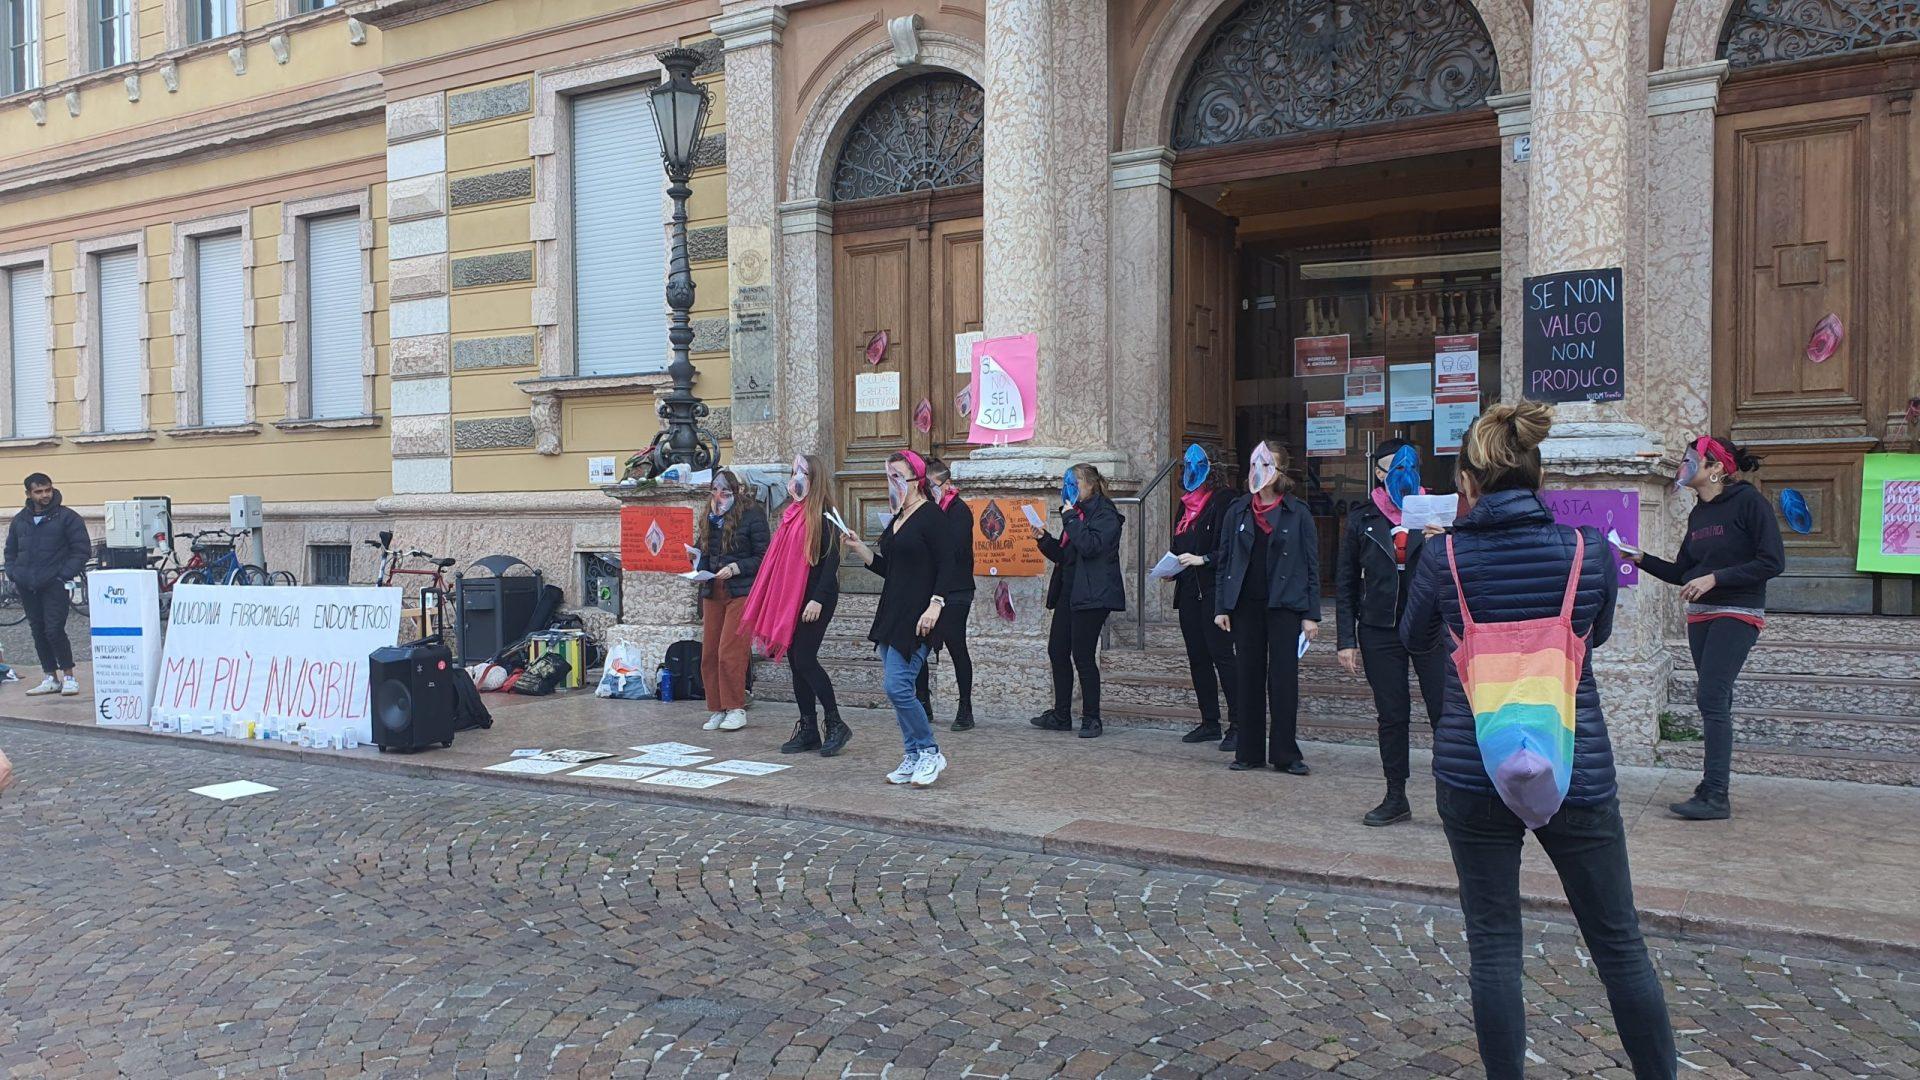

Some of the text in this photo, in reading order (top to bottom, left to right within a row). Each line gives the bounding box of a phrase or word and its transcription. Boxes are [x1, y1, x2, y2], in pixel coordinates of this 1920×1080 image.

[1530, 276, 1615, 311] SE NON
[1539, 311, 1602, 338] VALGO
[1551, 340, 1596, 361] NON
[1532, 366, 1618, 393] PRODUCO
[991, 391, 1009, 405] SEI
[981, 406, 1017, 425] SOLA
[1551, 499, 1593, 516] ASTA
[107, 585, 126, 596] Puro
[159, 656, 205, 710] MAI
[208, 650, 254, 712] PIÙ
